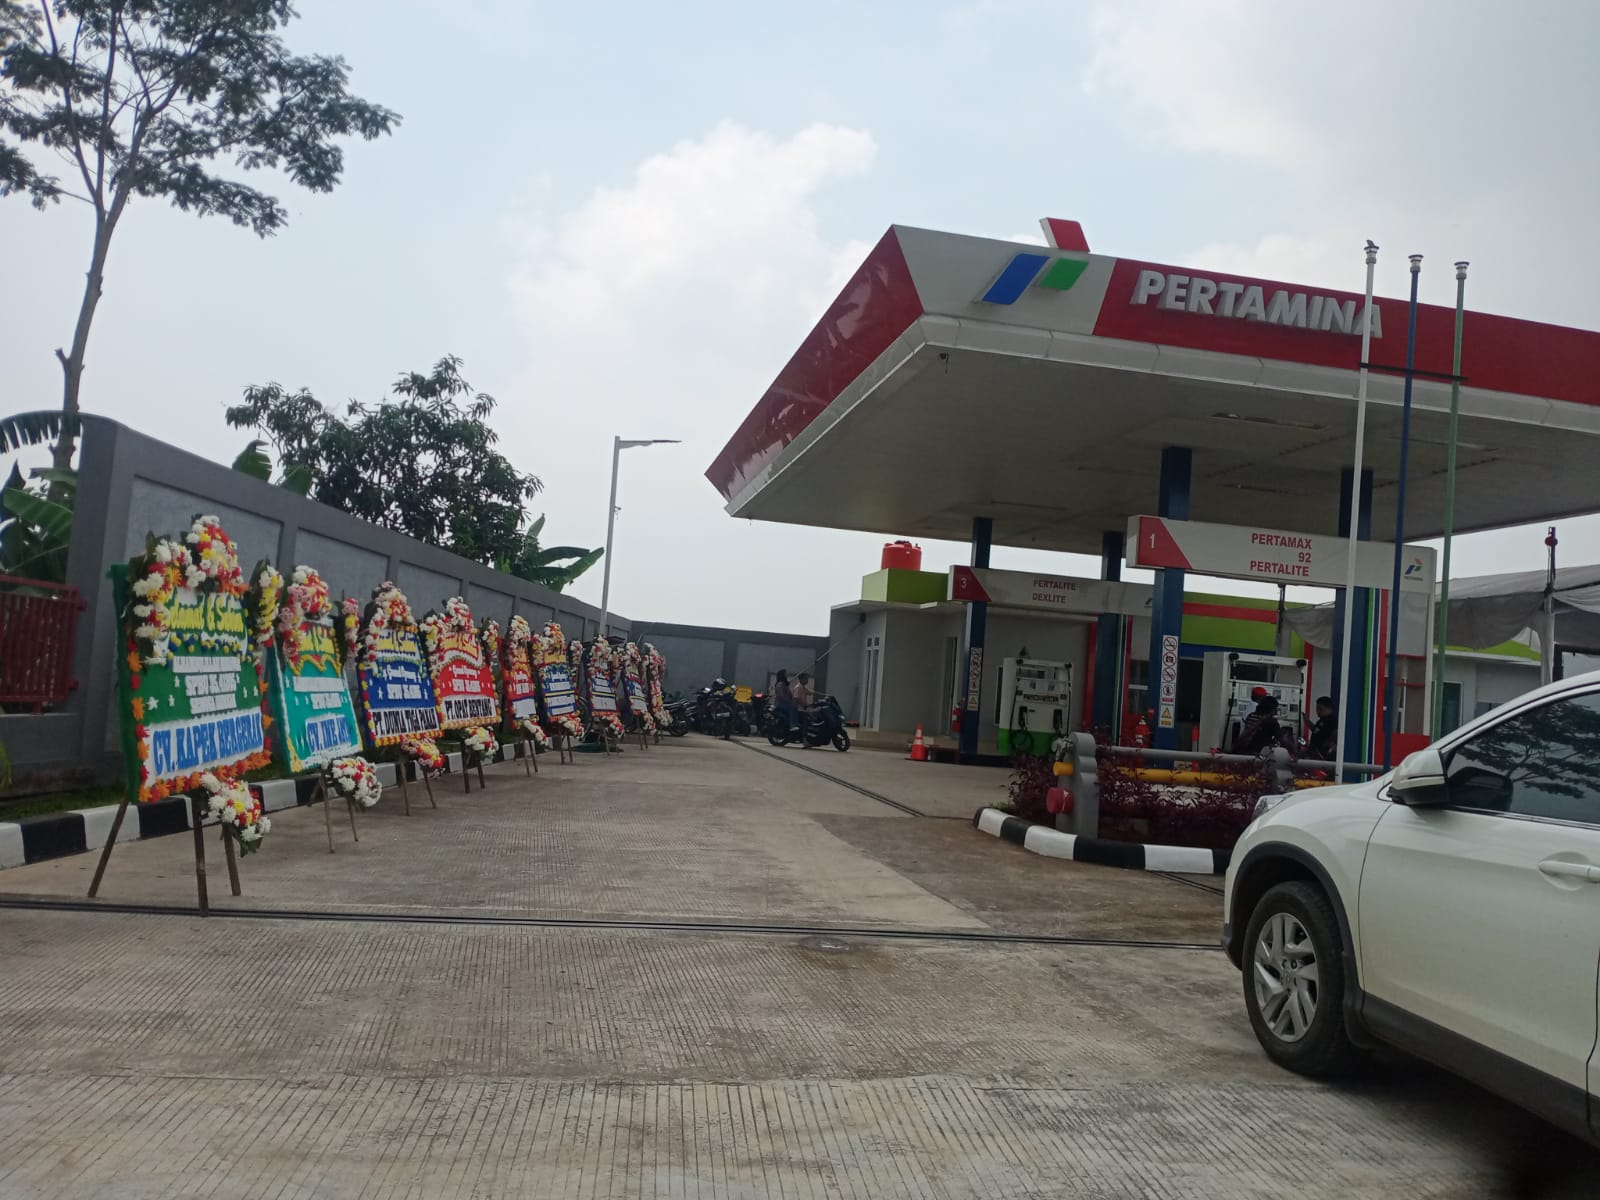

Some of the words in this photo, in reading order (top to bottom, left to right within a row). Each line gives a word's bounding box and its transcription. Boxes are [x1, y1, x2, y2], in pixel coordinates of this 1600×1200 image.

[1129, 270, 1382, 338] PERTAMINA
[1150, 533, 1156, 549] 1
[1251, 533, 1312, 550] PERTAMAX
[1298, 552, 1312, 563] 92
[1250, 560, 1309, 577] PERTALITE
[960, 577, 967, 589] 3
[1033, 579, 1077, 591] PERTALITE
[1032, 592, 1067, 604] DEXLITE
[153, 729, 176, 776] CV.
